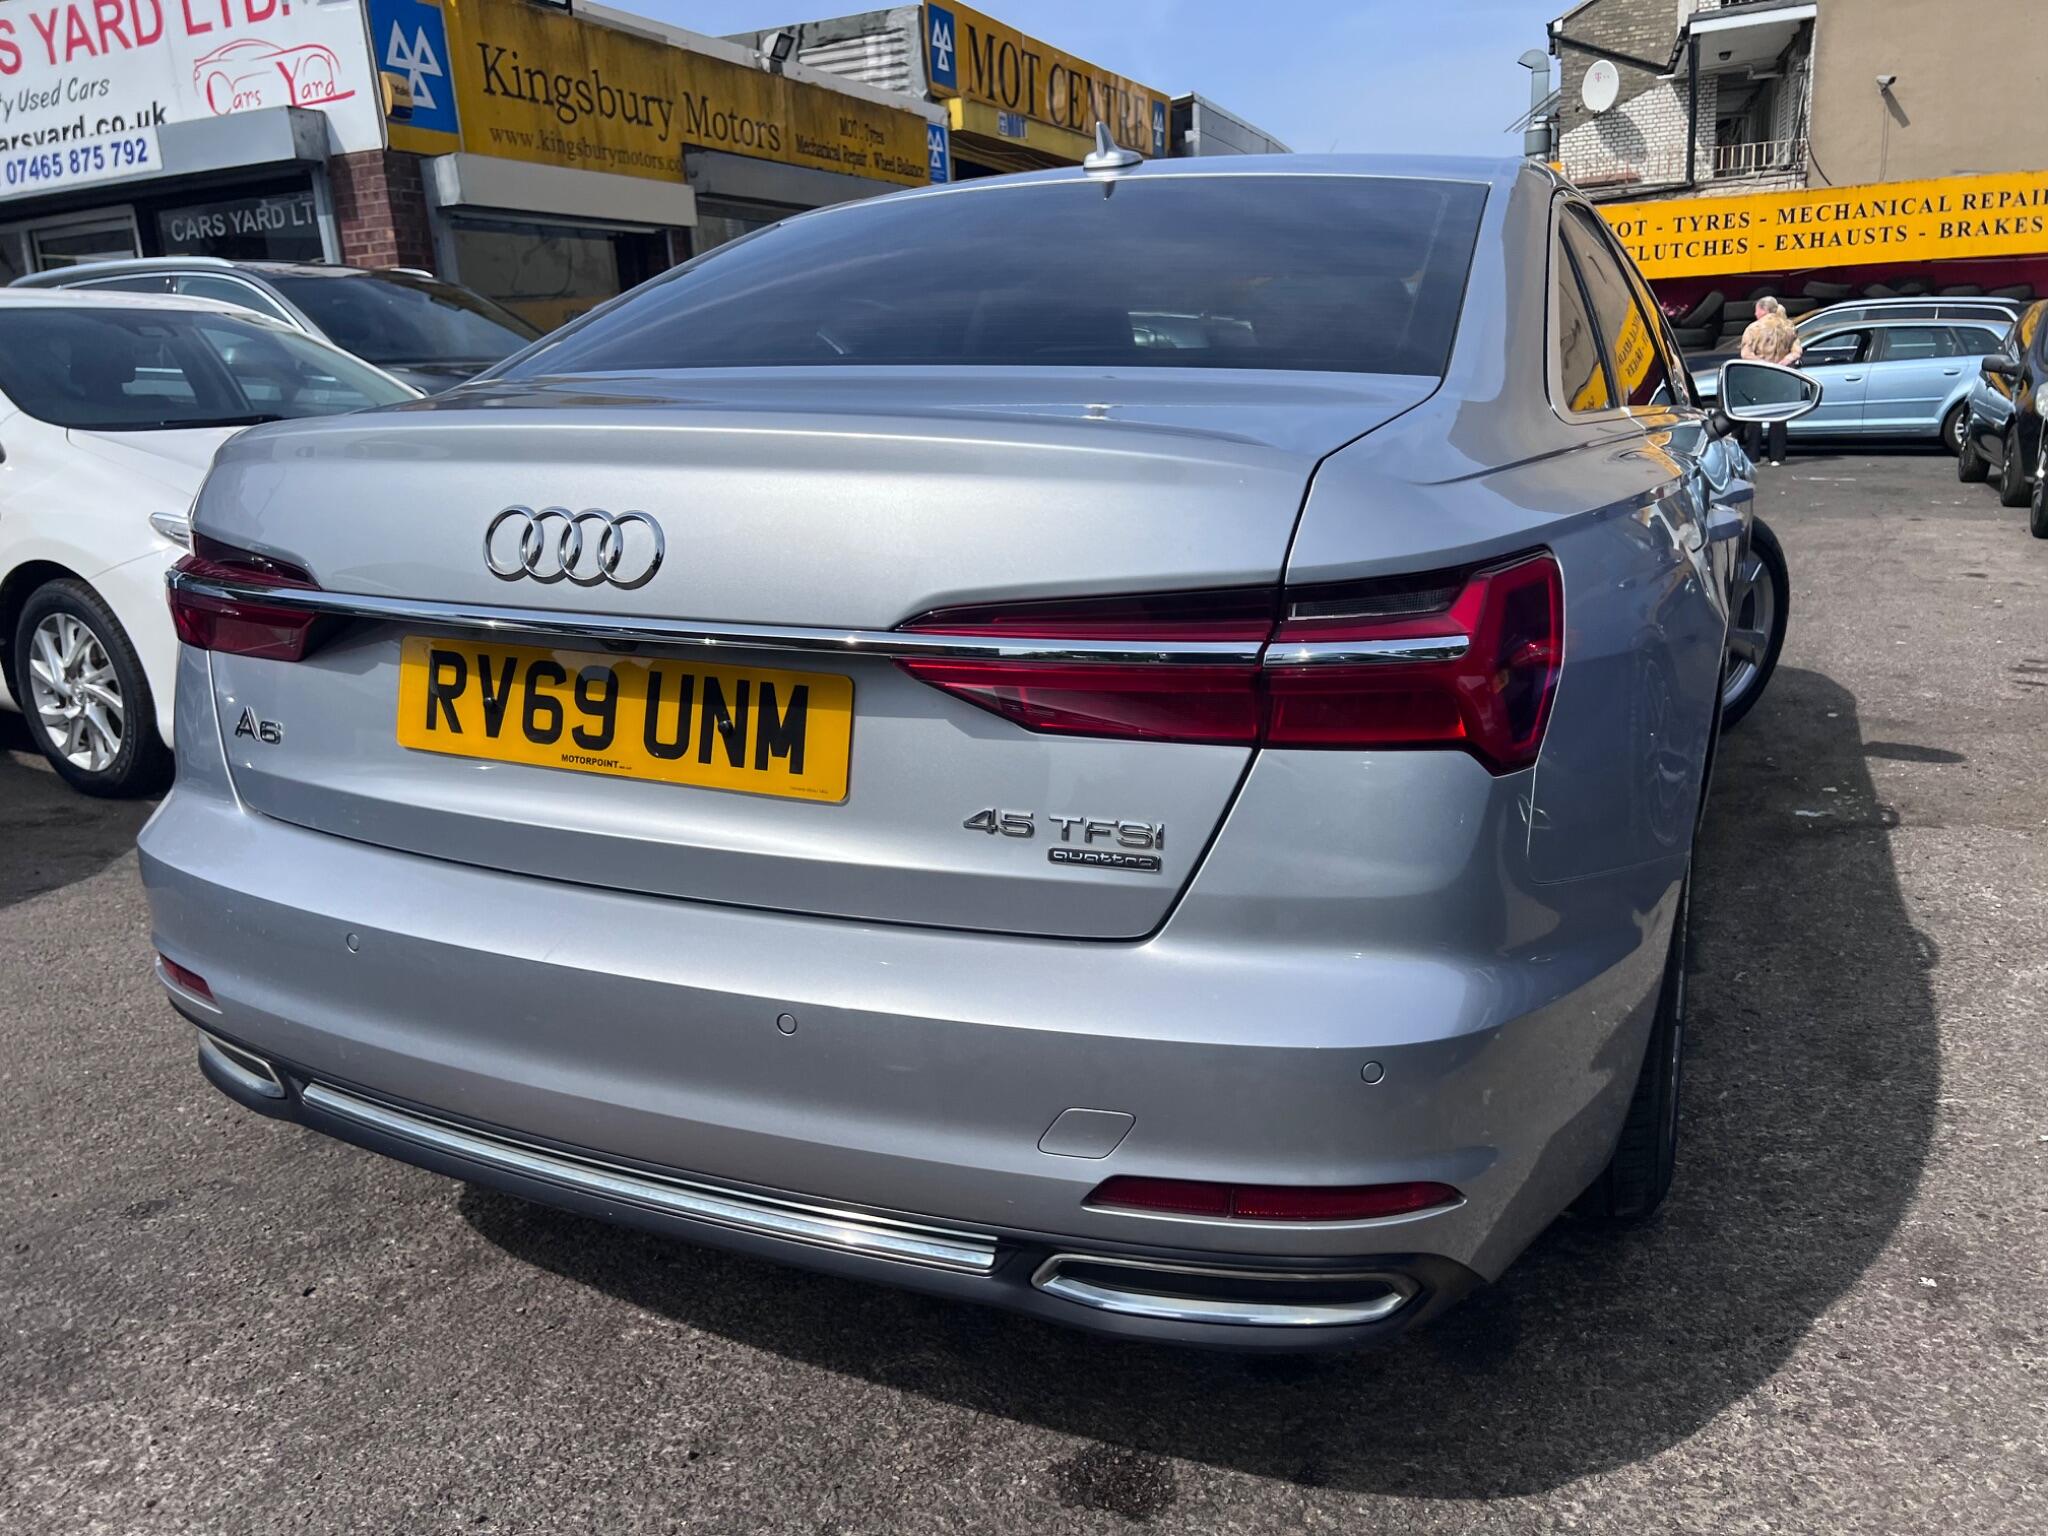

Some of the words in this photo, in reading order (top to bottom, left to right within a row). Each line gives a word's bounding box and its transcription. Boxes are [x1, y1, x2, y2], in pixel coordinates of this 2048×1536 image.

[29, 0, 165, 66] YARD
[0, 94, 14, 123] y
[18, 78, 62, 112] Used
[67, 76, 110, 102] Cars
[206, 70, 262, 116] Cars
[275, 55, 340, 107] Yard
[476, 42, 674, 142] Kingsbury
[683, 91, 781, 152] Motors
[965, 23, 1041, 116] MOT
[1048, 64, 1146, 150] CENTRE
[6, 152, 64, 184] 07465
[69, 144, 105, 174] 875
[110, 137, 148, 167] 792
[170, 213, 227, 242] CARS
[229, 205, 286, 234] YARD
[1609, 219, 1648, 238] OT
[1672, 211, 1751, 234] TYRES
[1776, 195, 1952, 226] MECHANICAL
[1774, 224, 1908, 252] EXHAUSTS
[1938, 215, 2044, 239] BRAKES
[234, 705, 284, 746] A6
[425, 649, 620, 752] RV69
[643, 670, 810, 776] UNM
[561, 753, 620, 769] MOTORPOINT
[962, 807, 1036, 839] 45
[1048, 815, 1166, 851] TFSI
[1052, 850, 1154, 868] quattro
